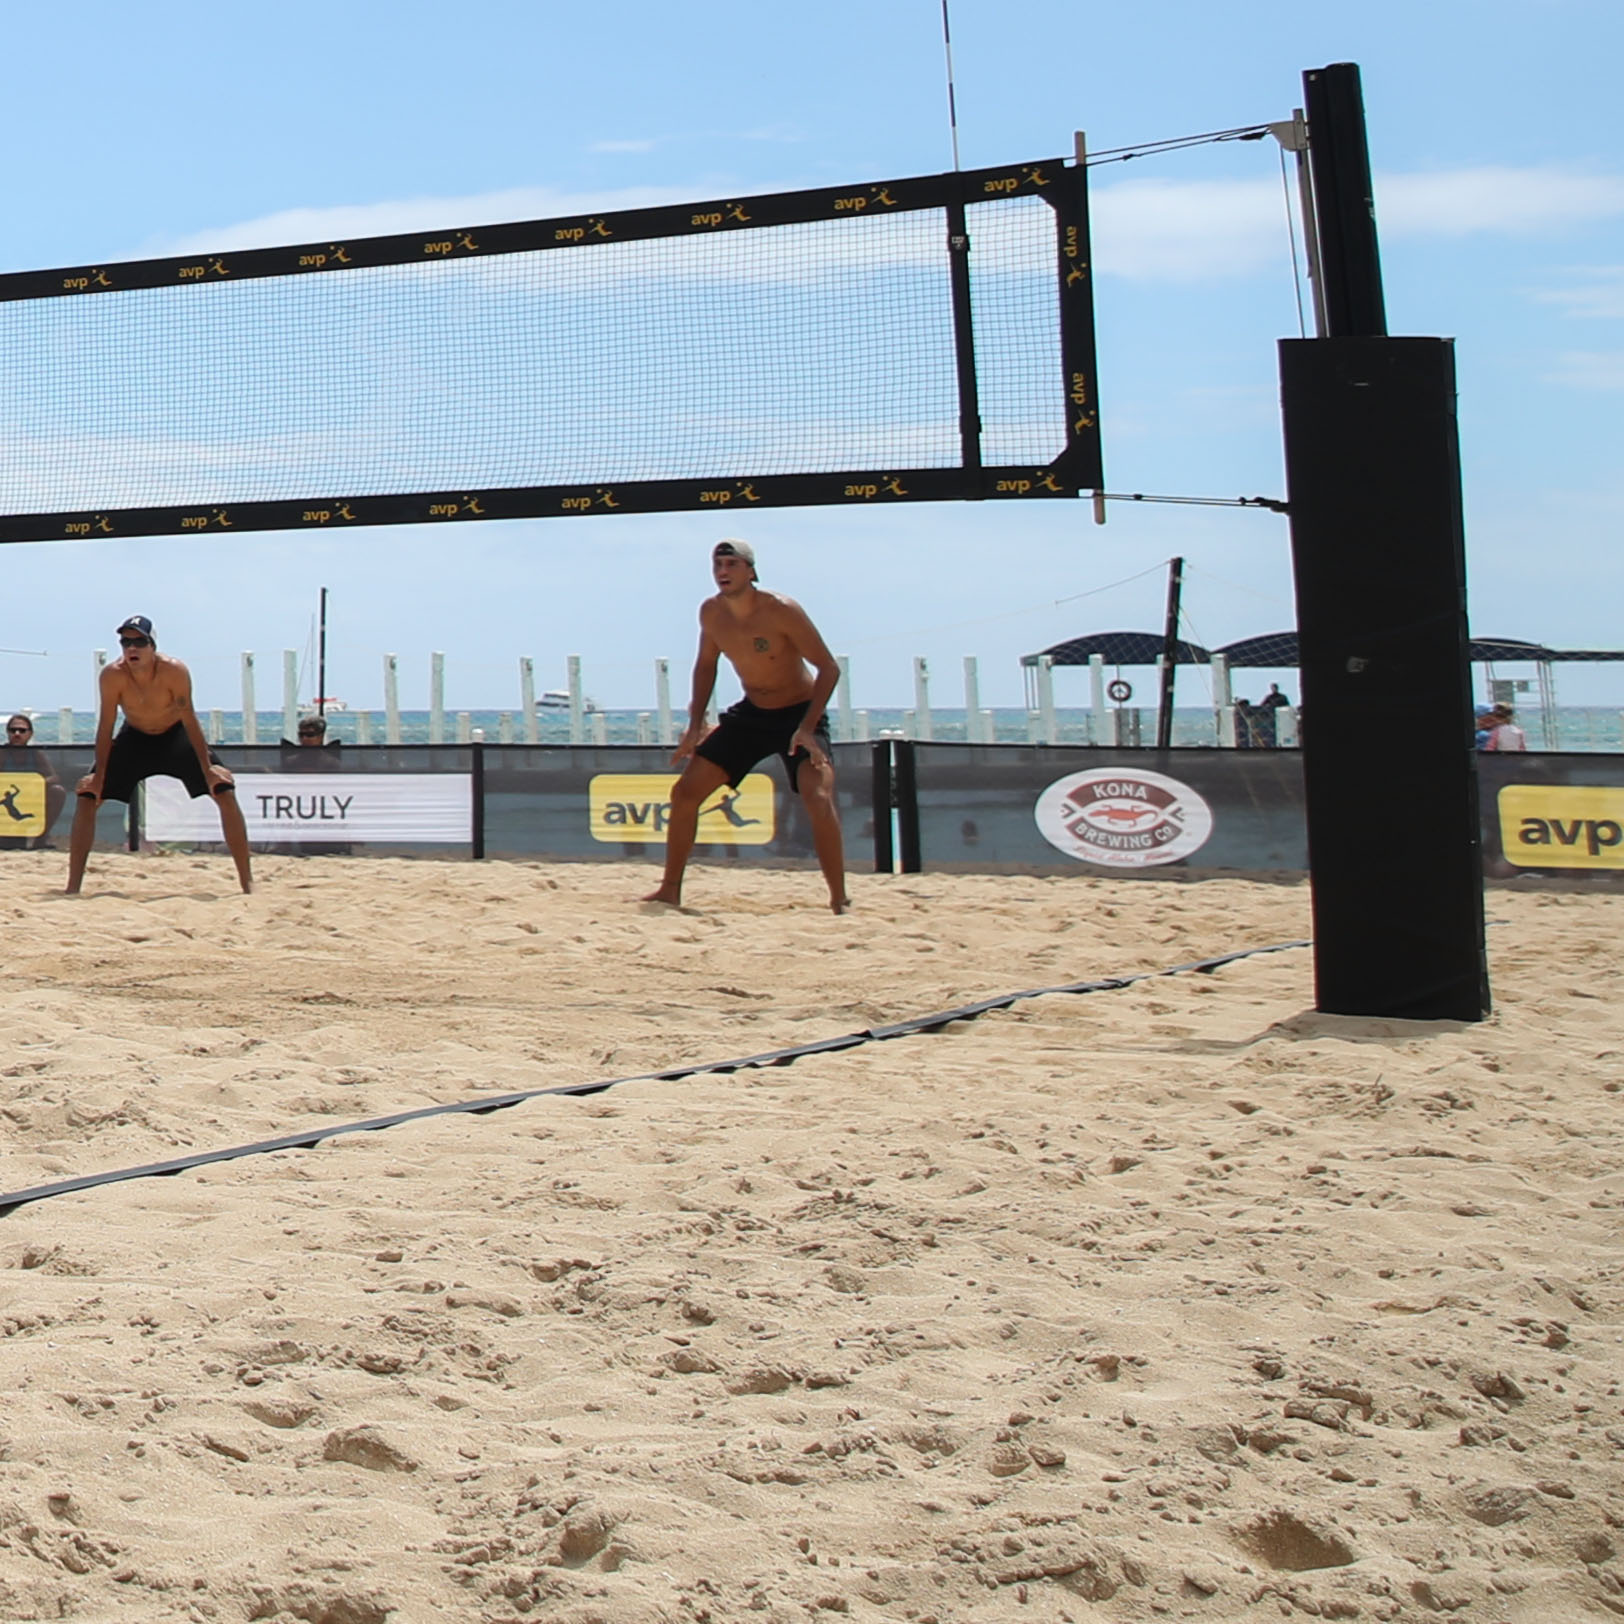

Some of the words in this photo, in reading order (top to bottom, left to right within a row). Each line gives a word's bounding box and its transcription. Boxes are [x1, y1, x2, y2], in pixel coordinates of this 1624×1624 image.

[984, 178, 1020, 193] avp
[835, 197, 868, 212] avp
[692, 213, 724, 228] avp
[556, 228, 586, 242] avp
[1064, 226, 1078, 257] avp
[425, 242, 454, 256] avp
[300, 254, 328, 268] avp
[180, 266, 206, 280] avp
[64, 278, 90, 290] avp
[1070, 372, 1086, 405] avp
[845, 484, 879, 498] avp
[997, 480, 1032, 494] avp
[562, 497, 592, 511] avp
[701, 490, 732, 506] avp
[430, 504, 460, 518] avp
[182, 517, 208, 530] avp
[304, 512, 332, 525] avp
[67, 523, 92, 535] avp
[1093, 782, 1148, 800] KONA
[256, 795, 354, 819] TRULY
[603, 802, 672, 832] avp
[1074, 822, 1152, 849] BREWING
[1518, 817, 1623, 857] avp
